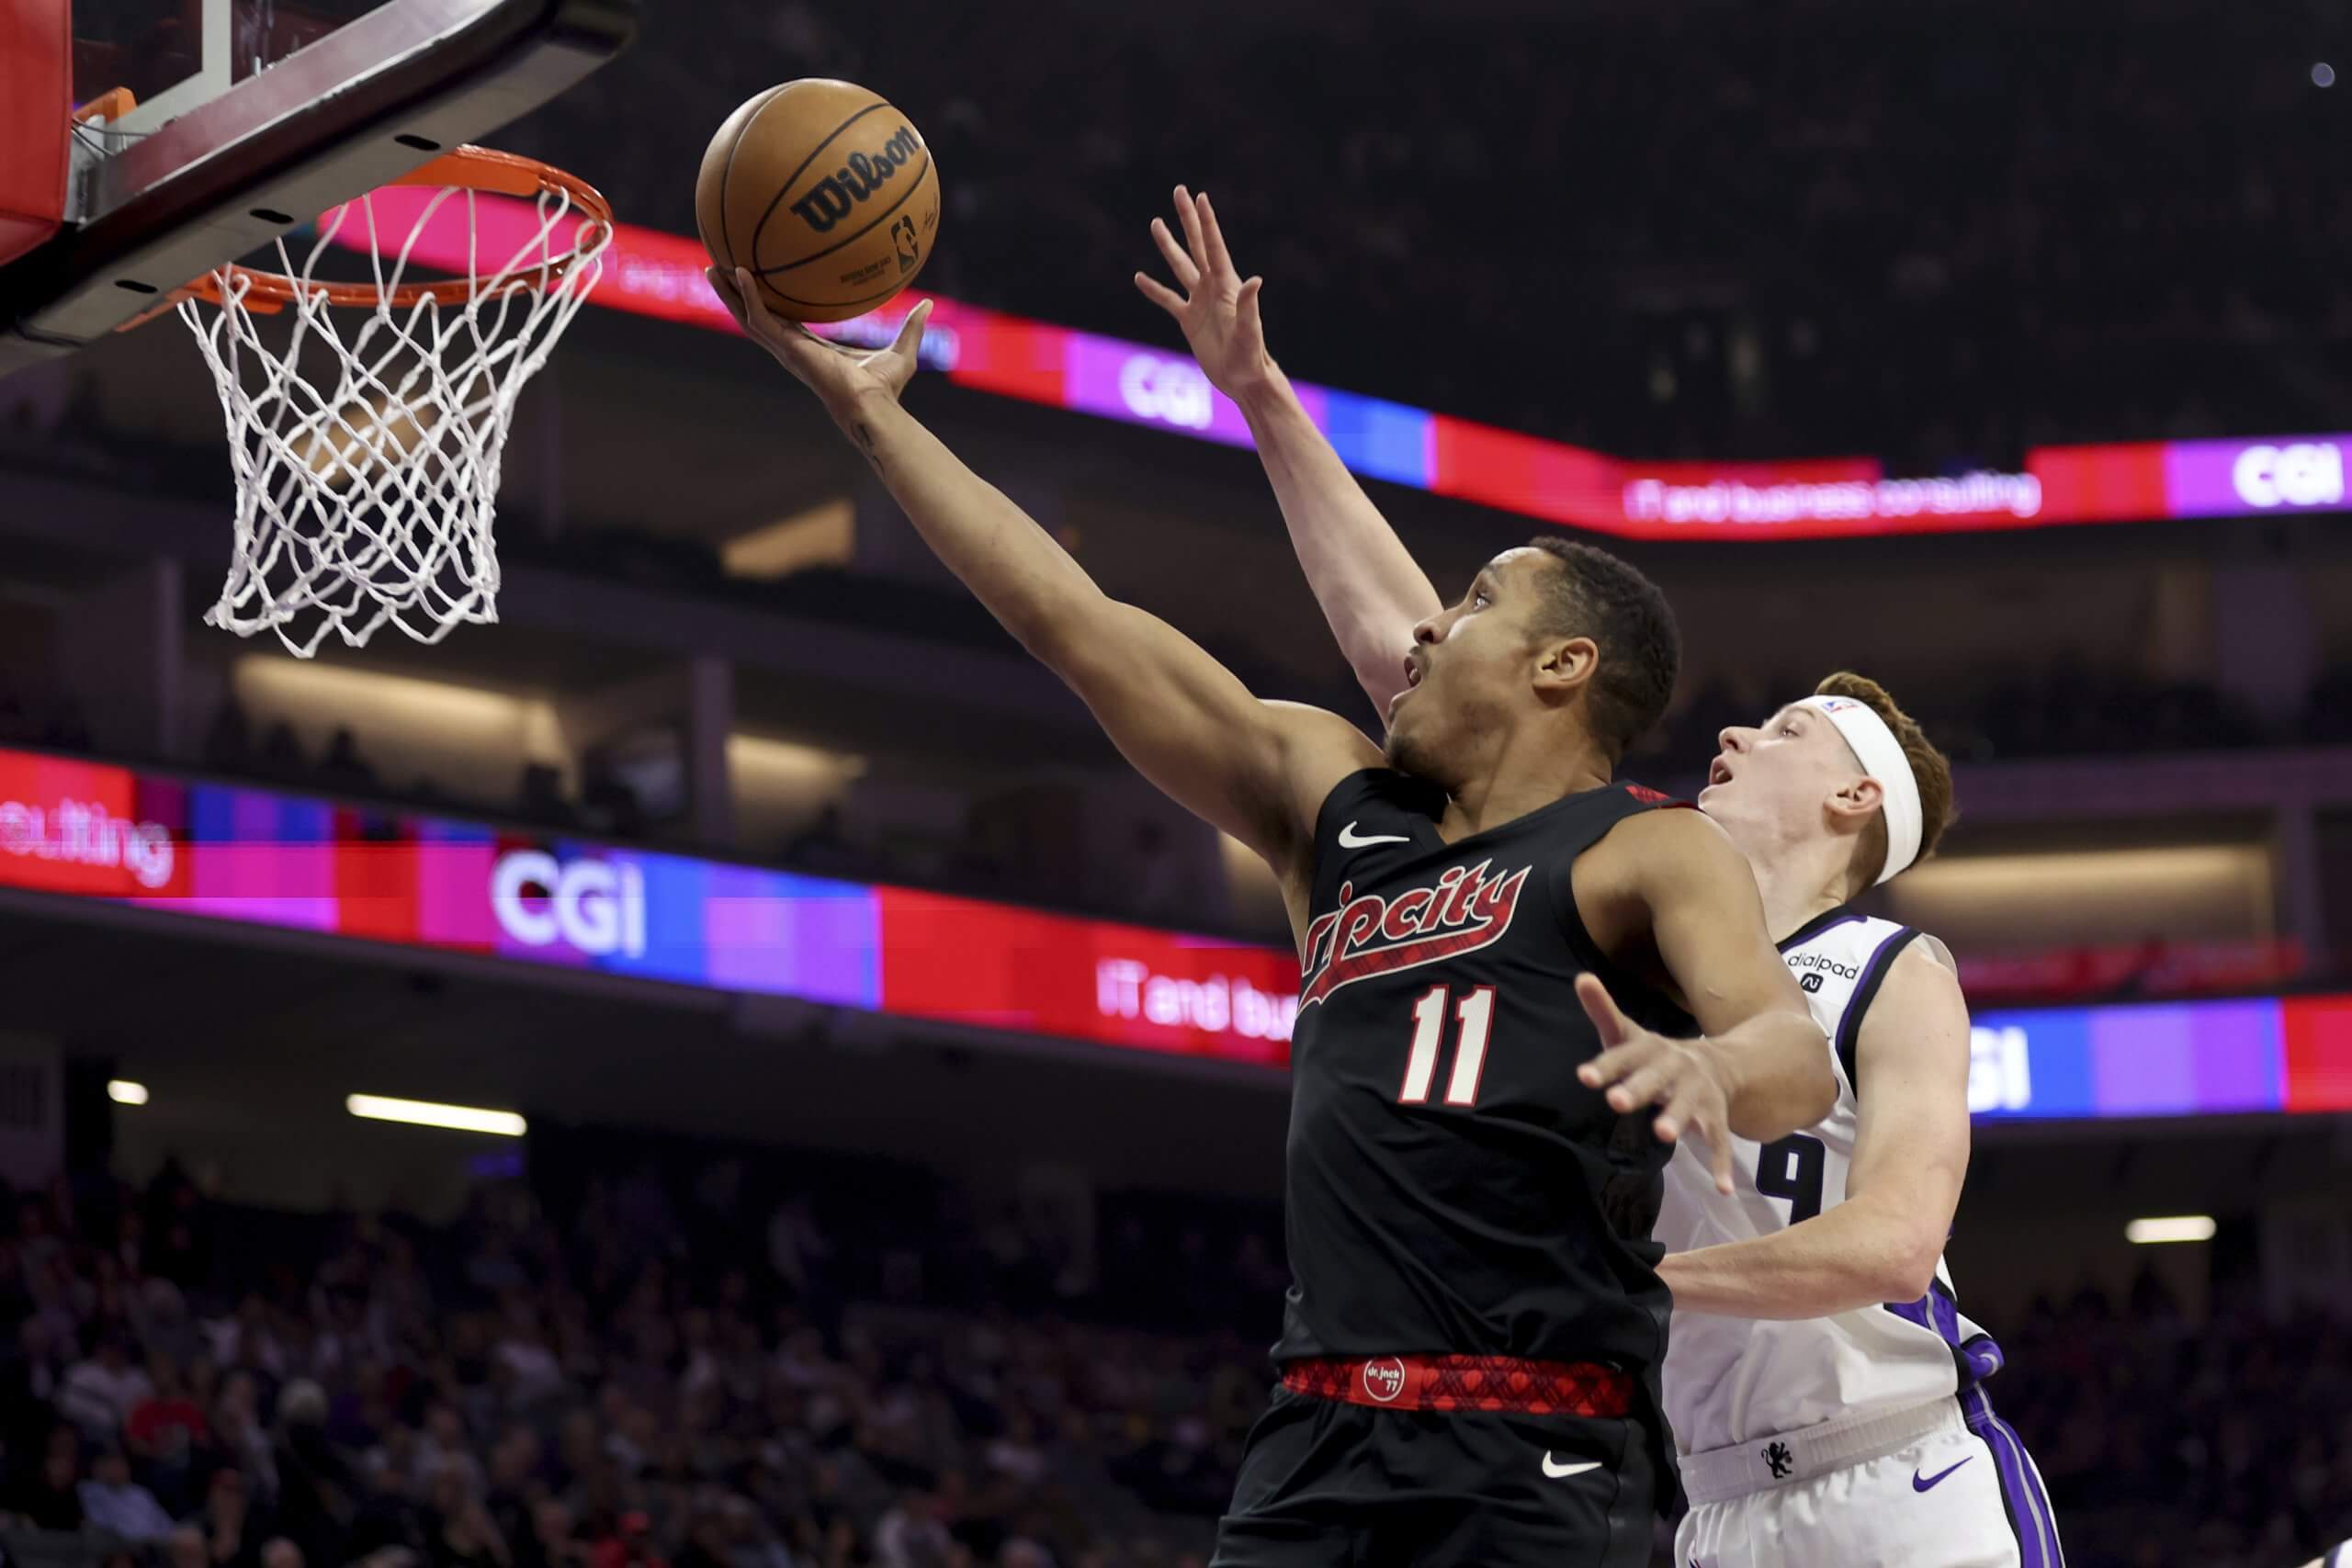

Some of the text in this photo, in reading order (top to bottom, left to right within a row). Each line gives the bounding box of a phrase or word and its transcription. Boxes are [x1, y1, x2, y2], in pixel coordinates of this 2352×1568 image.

[790, 125, 921, 233] Wilson
[1118, 354, 1214, 430] CGI
[2233, 443, 2345, 508] CGI
[492, 850, 645, 959] CGI
[1144, 974, 1231, 1032] and
[1788, 953, 1860, 979] dialpad
[1379, 985, 1497, 1107] 11
[1756, 1133, 1826, 1225] 9
